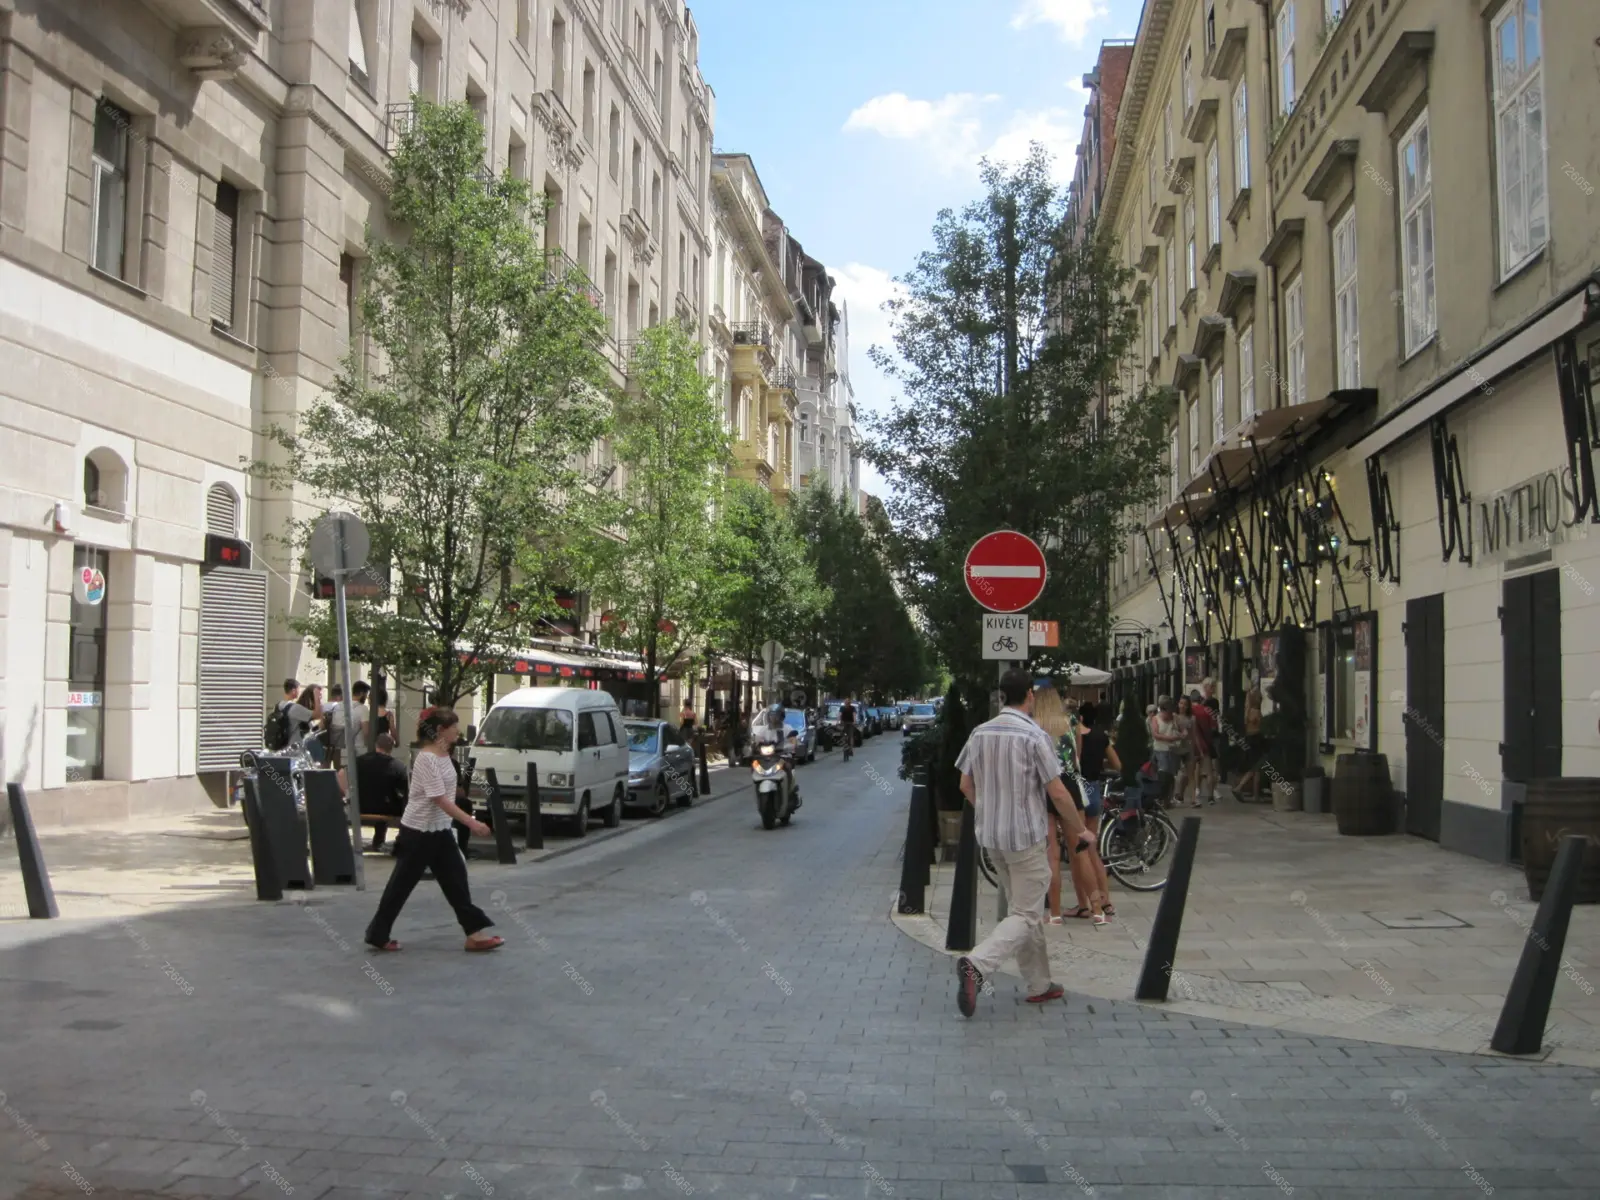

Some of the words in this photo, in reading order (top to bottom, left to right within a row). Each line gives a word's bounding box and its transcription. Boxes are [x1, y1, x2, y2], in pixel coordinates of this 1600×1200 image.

[1481, 467, 1576, 555] MYTHOS
[986, 616, 1025, 630] KIVÉVE
[1030, 621, 1049, 632] 501
